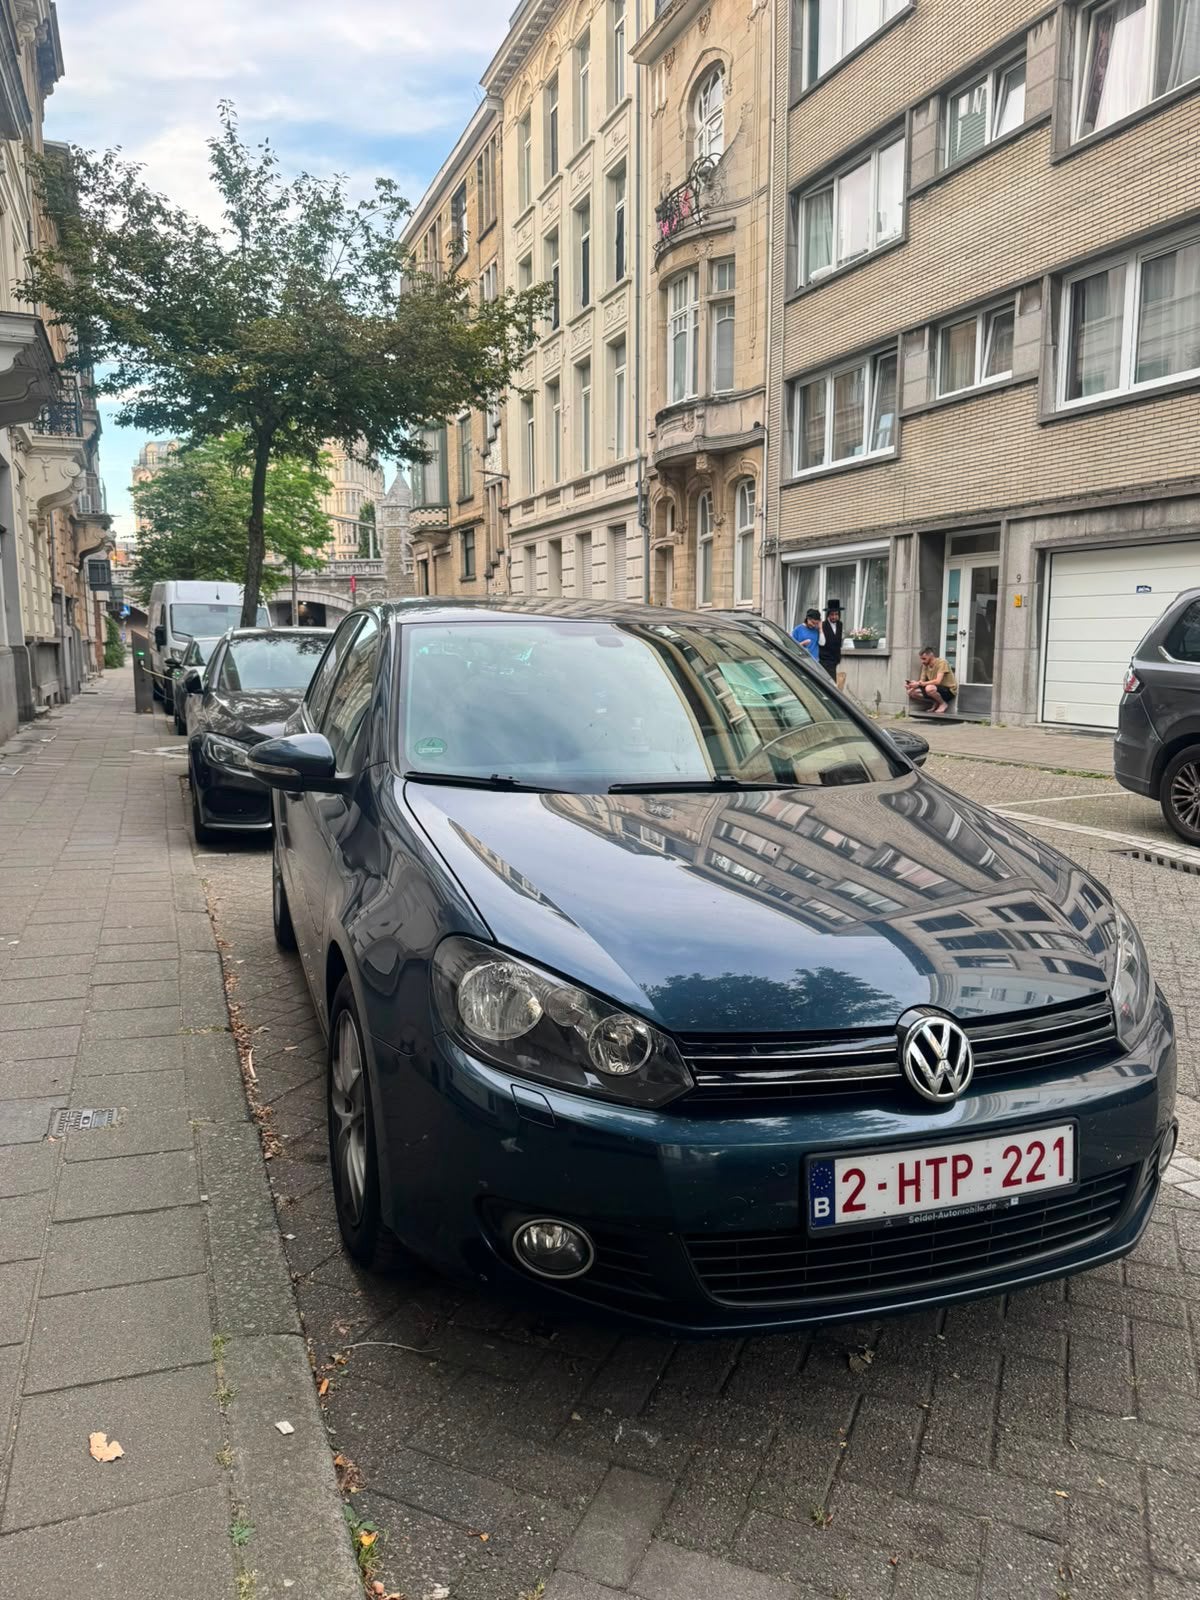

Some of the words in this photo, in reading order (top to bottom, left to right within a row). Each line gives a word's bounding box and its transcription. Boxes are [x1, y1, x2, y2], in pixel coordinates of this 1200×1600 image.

[1016, 573, 1022, 583] 9
[842, 1136, 1065, 1213] 2-HTP-221
[813, 1197, 831, 1218] B
[908, 1203, 997, 1224] Seidel-Automobile.de
